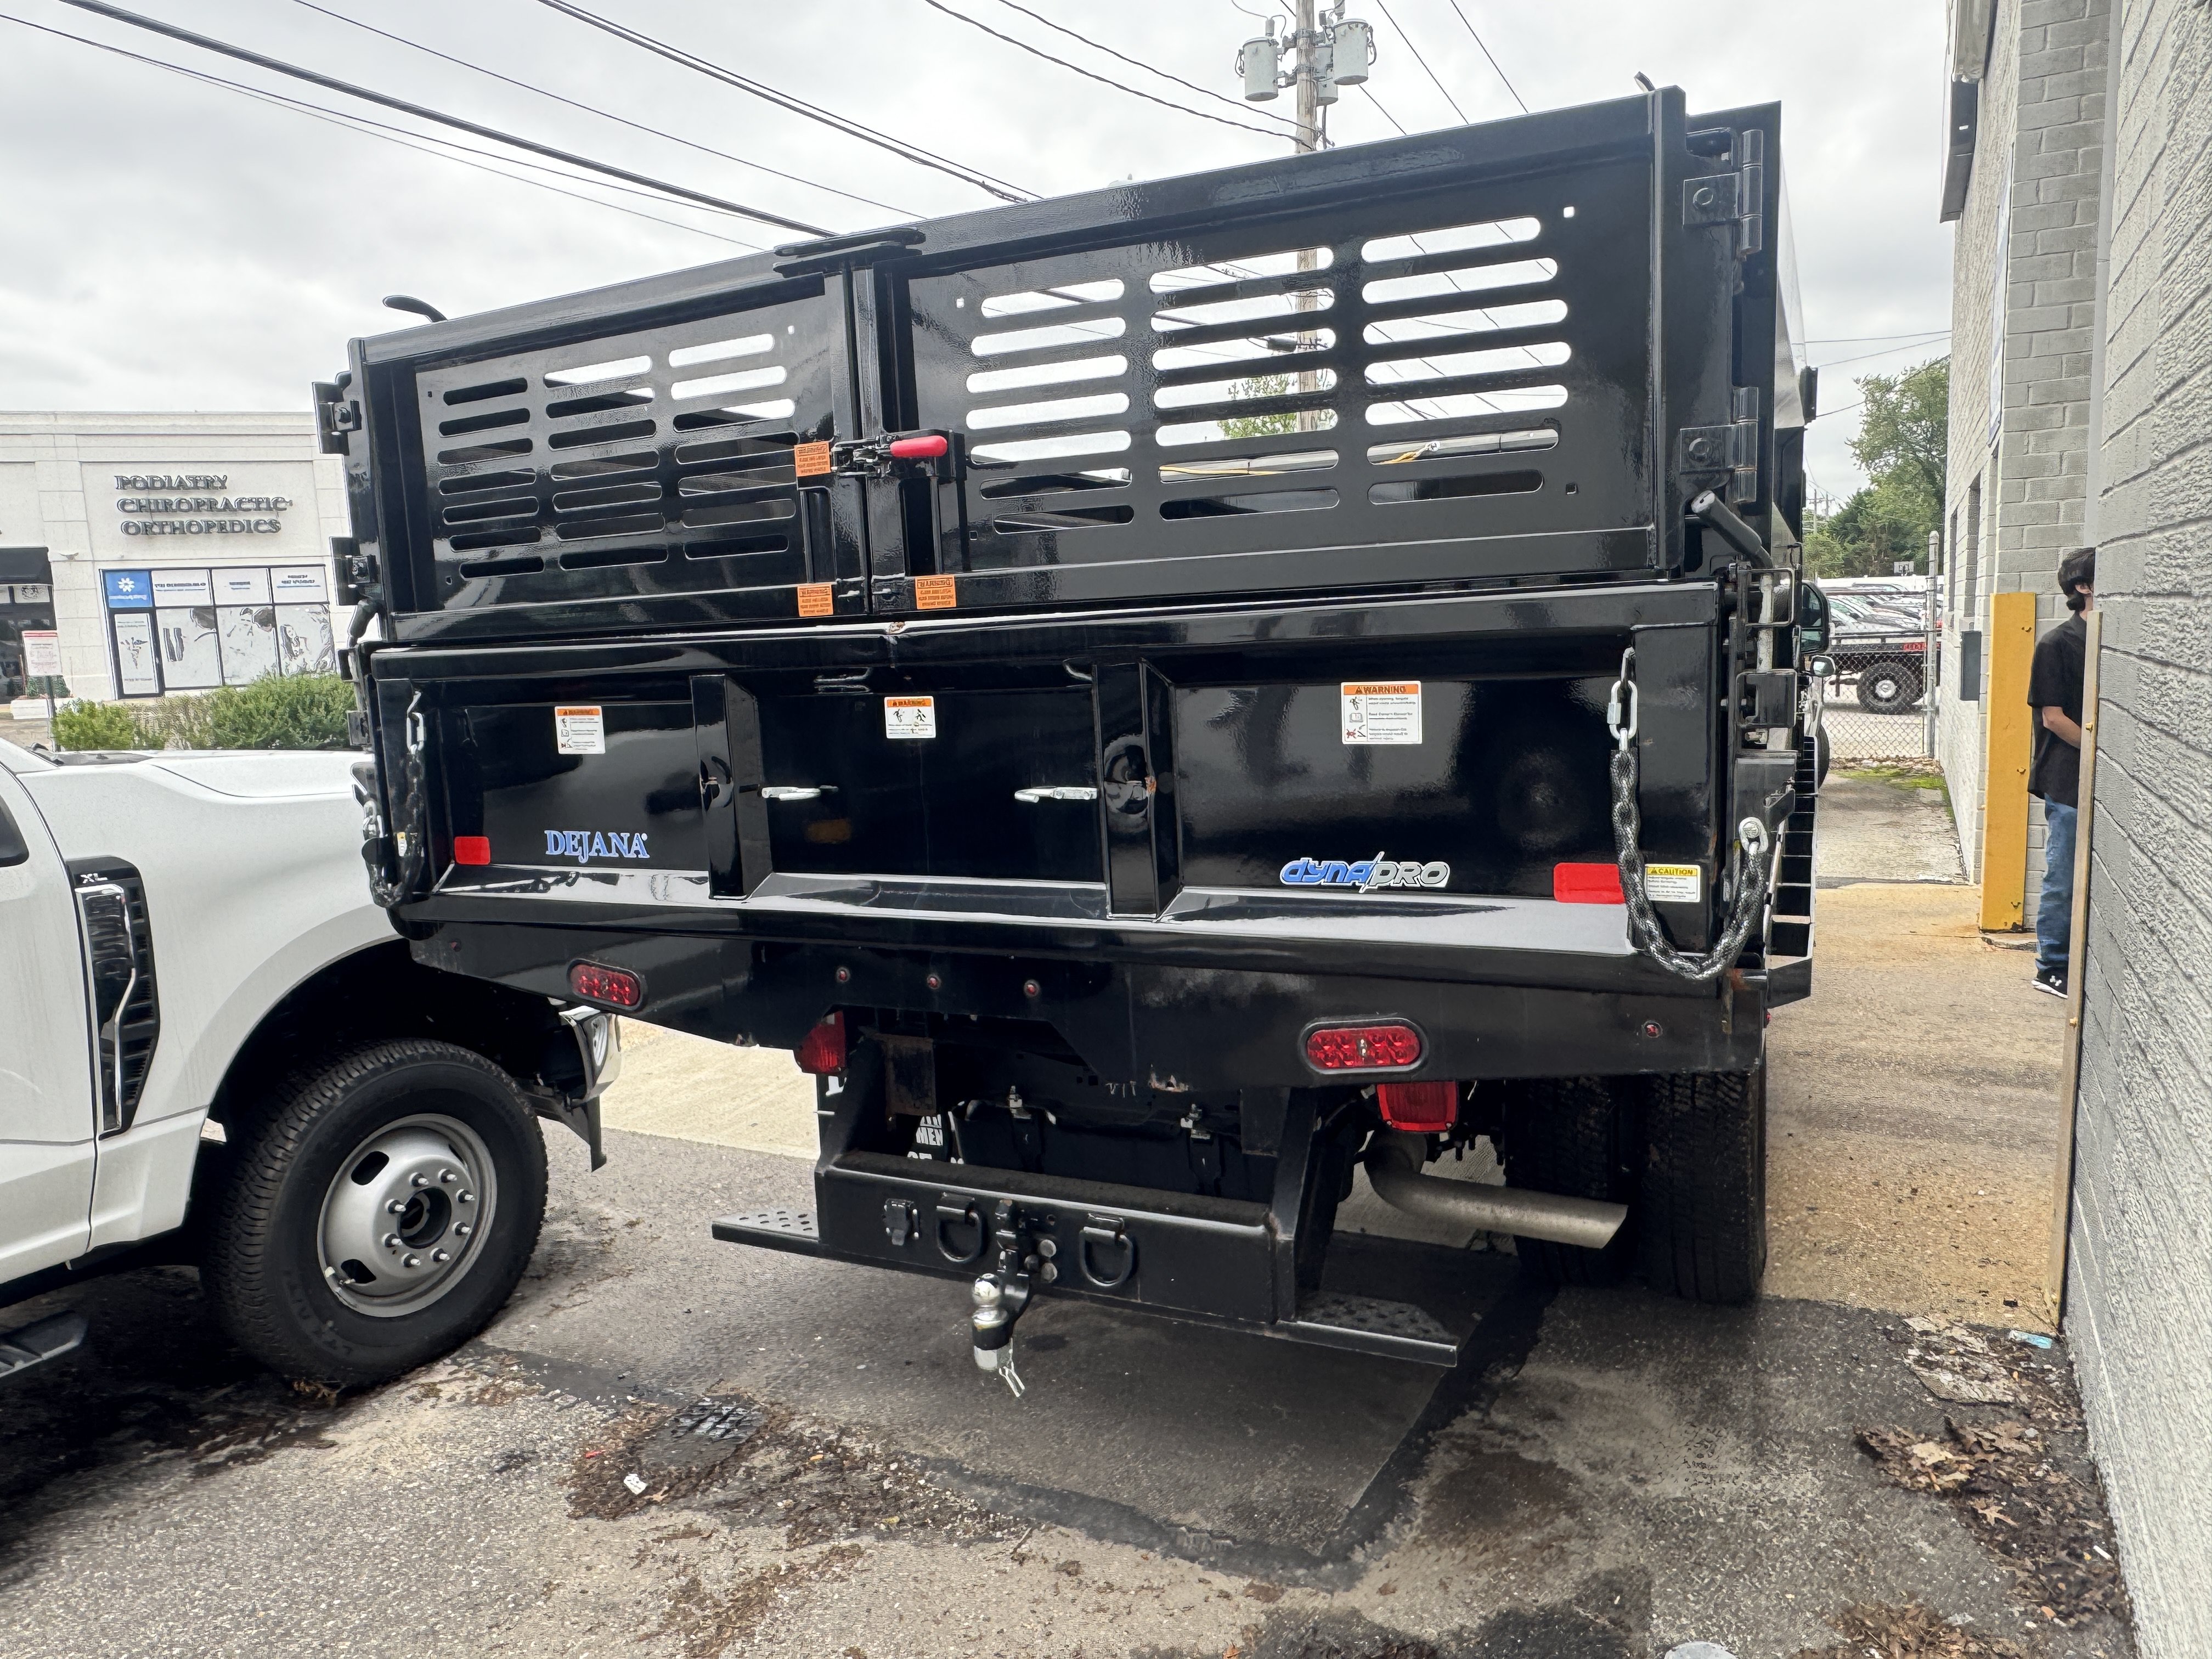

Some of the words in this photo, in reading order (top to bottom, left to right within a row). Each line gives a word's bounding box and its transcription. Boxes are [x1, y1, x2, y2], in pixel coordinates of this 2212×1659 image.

[114, 475, 228, 490] PODIATRY
[116, 496, 288, 513] CHIROPRACTIC
[120, 518, 282, 535] ORTHOPEDICS
[1363, 685, 1407, 694] WARNING
[544, 830, 651, 864] DEJANA
[80, 872, 109, 884] XL
